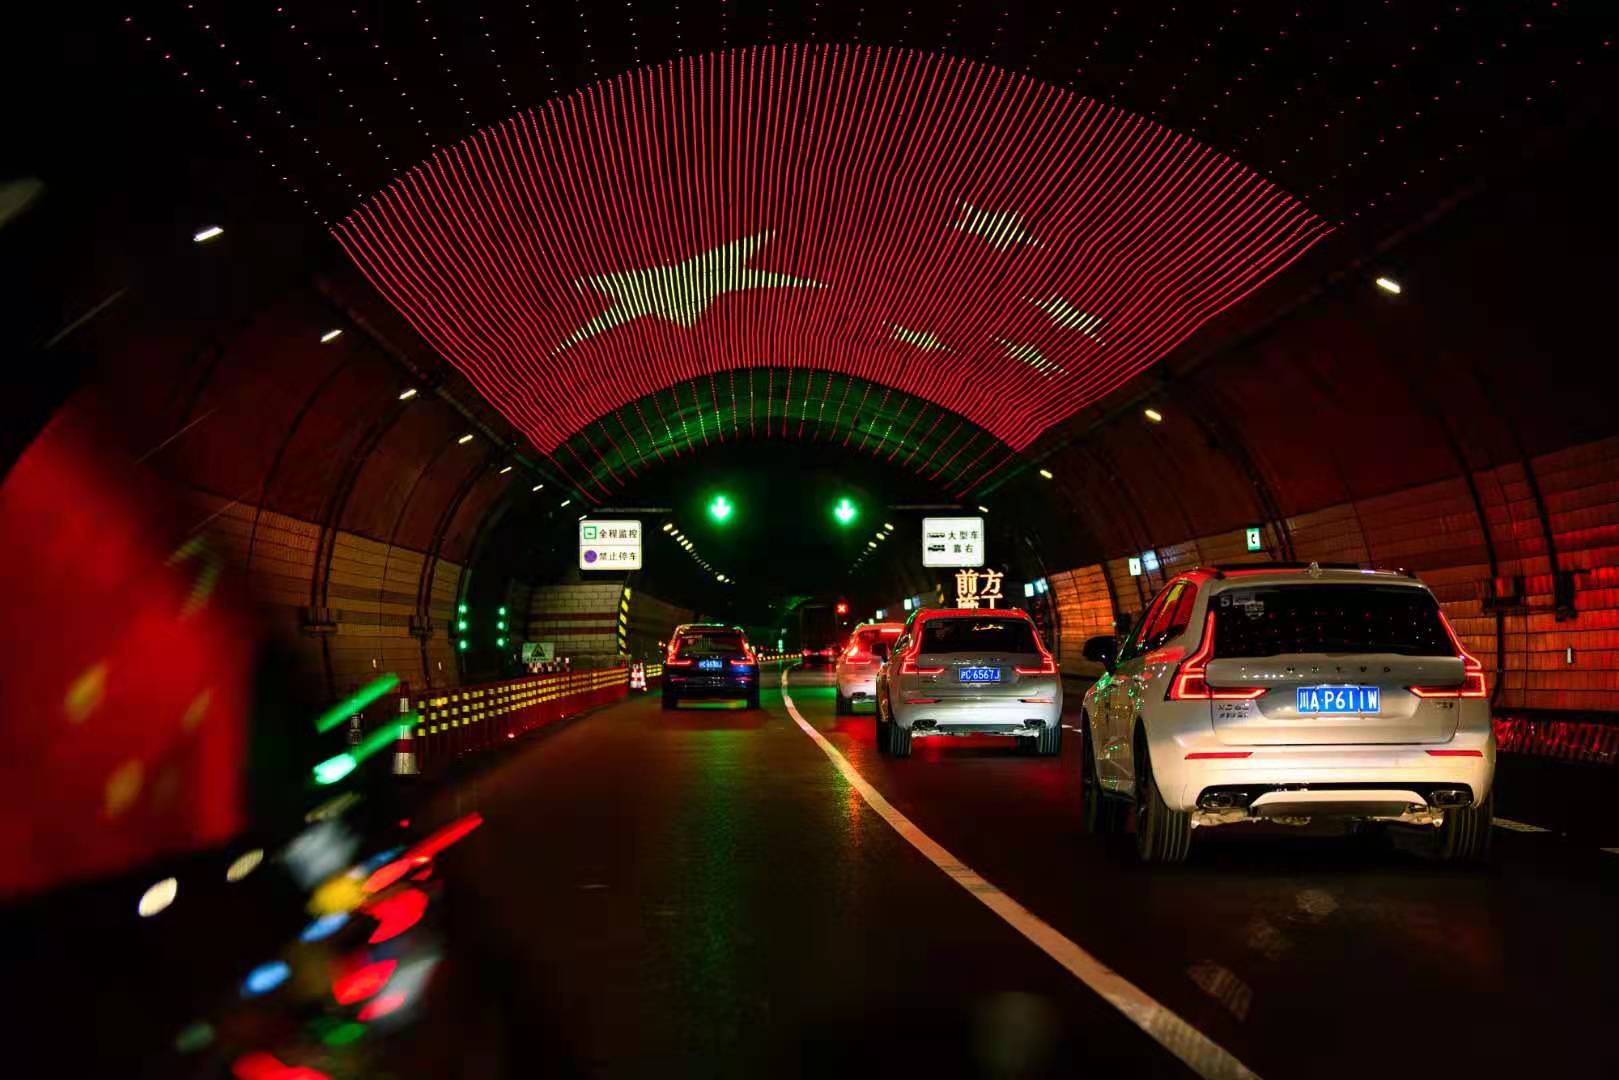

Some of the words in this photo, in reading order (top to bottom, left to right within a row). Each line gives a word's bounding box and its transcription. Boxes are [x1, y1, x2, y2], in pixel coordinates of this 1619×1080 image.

[599, 528, 637, 539] 全程监控
[948, 530, 978, 540] 大型车
[953, 543, 974, 553] 靠右
[599, 551, 637, 561] 禁止停车
[955, 568, 1004, 594] 前方
